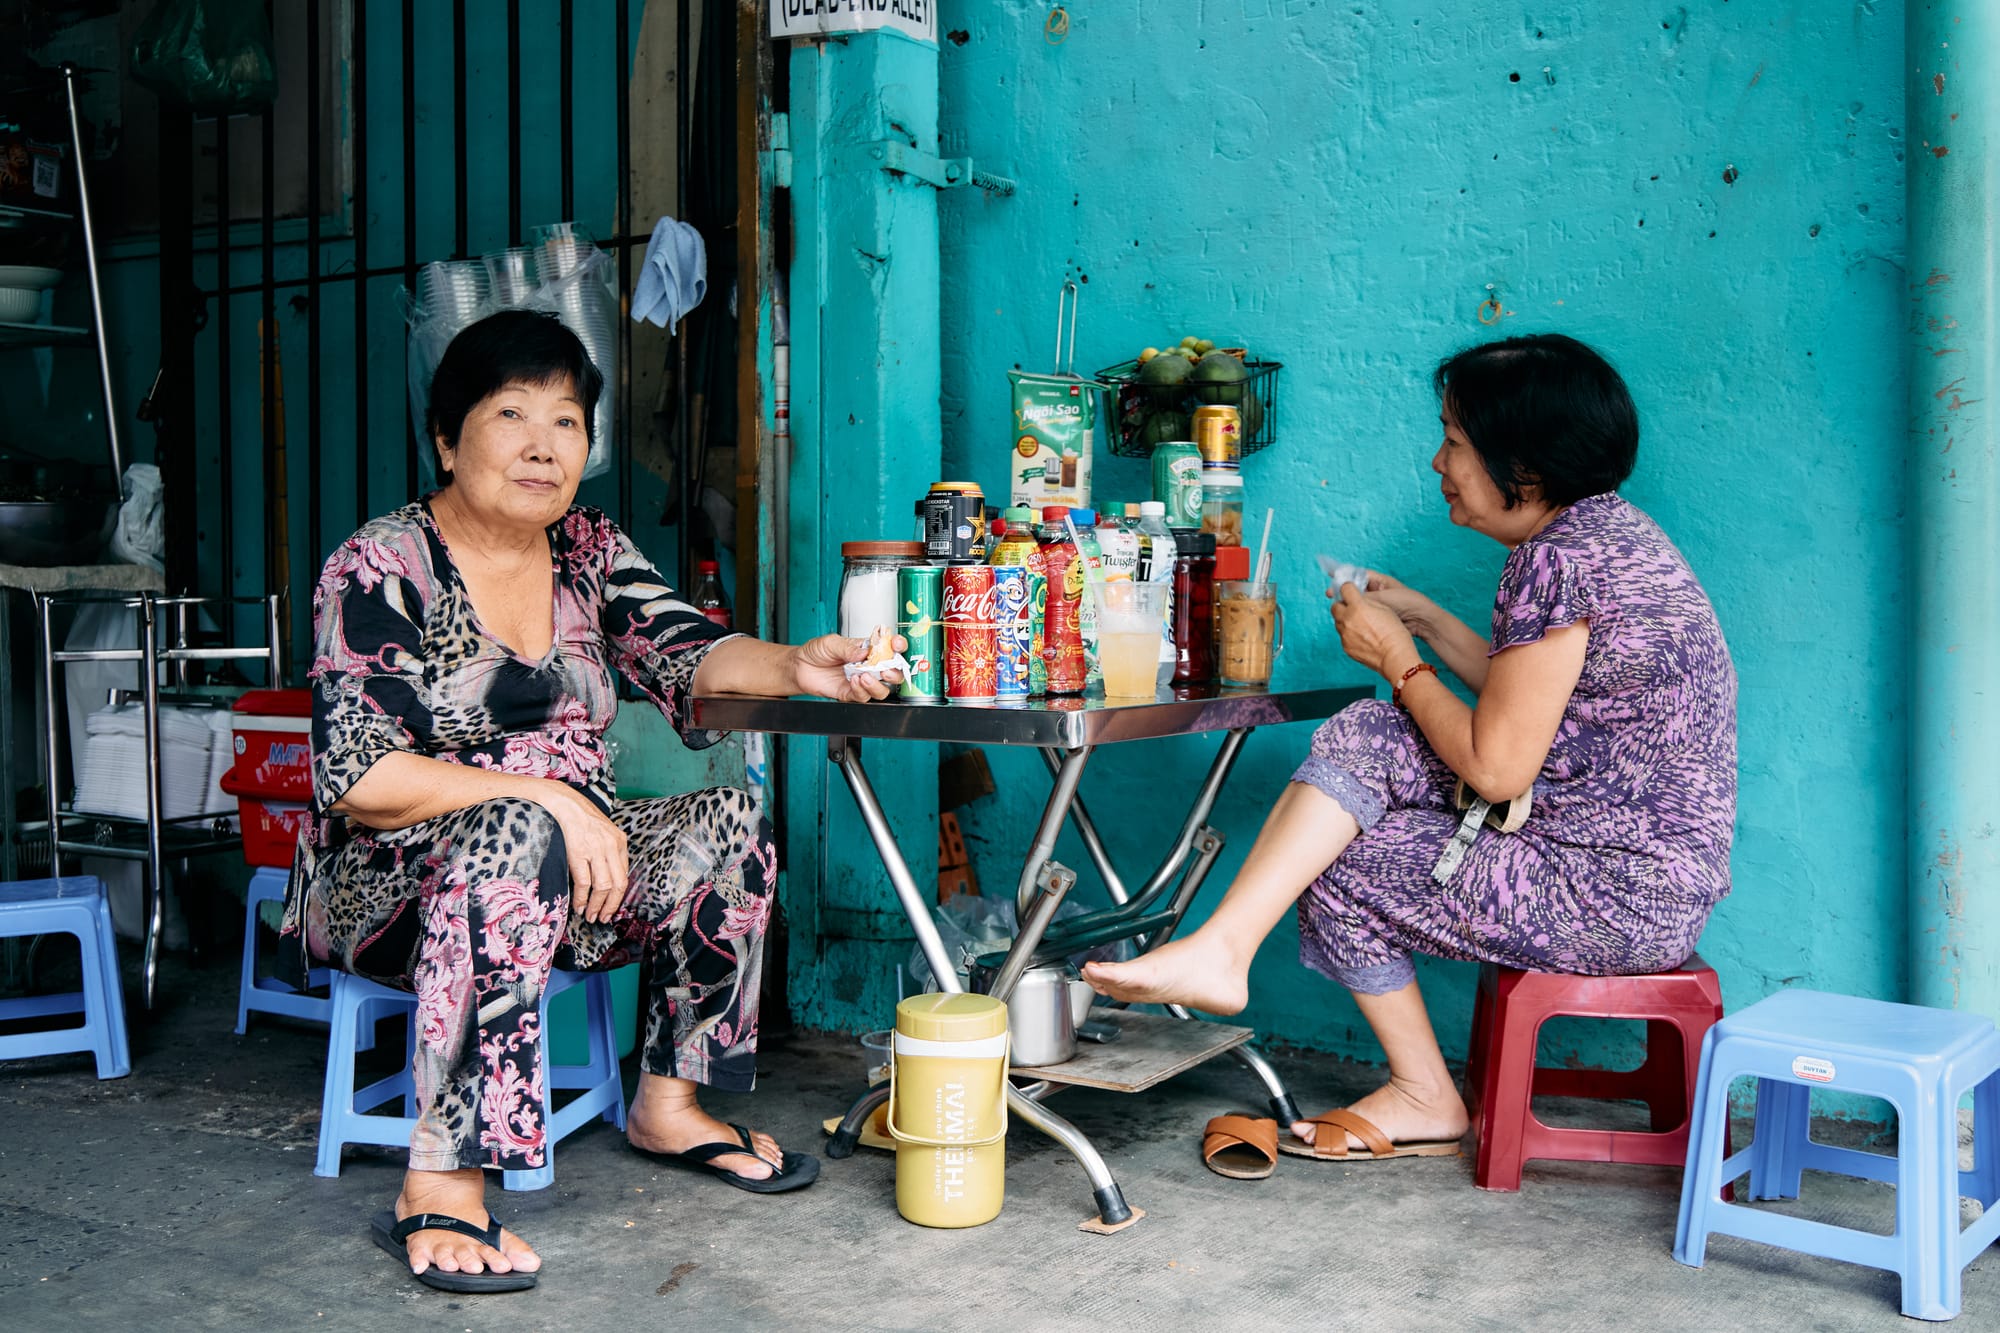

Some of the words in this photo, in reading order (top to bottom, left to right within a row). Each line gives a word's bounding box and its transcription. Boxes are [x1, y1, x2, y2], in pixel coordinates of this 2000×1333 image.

[891, 0, 933, 37] ALLEY)
[1056, 403, 1080, 416] Sao
[1102, 553, 1137, 570] Twister
[935, 1088, 943, 1113] think
[967, 1117, 976, 1163] BOTLE
